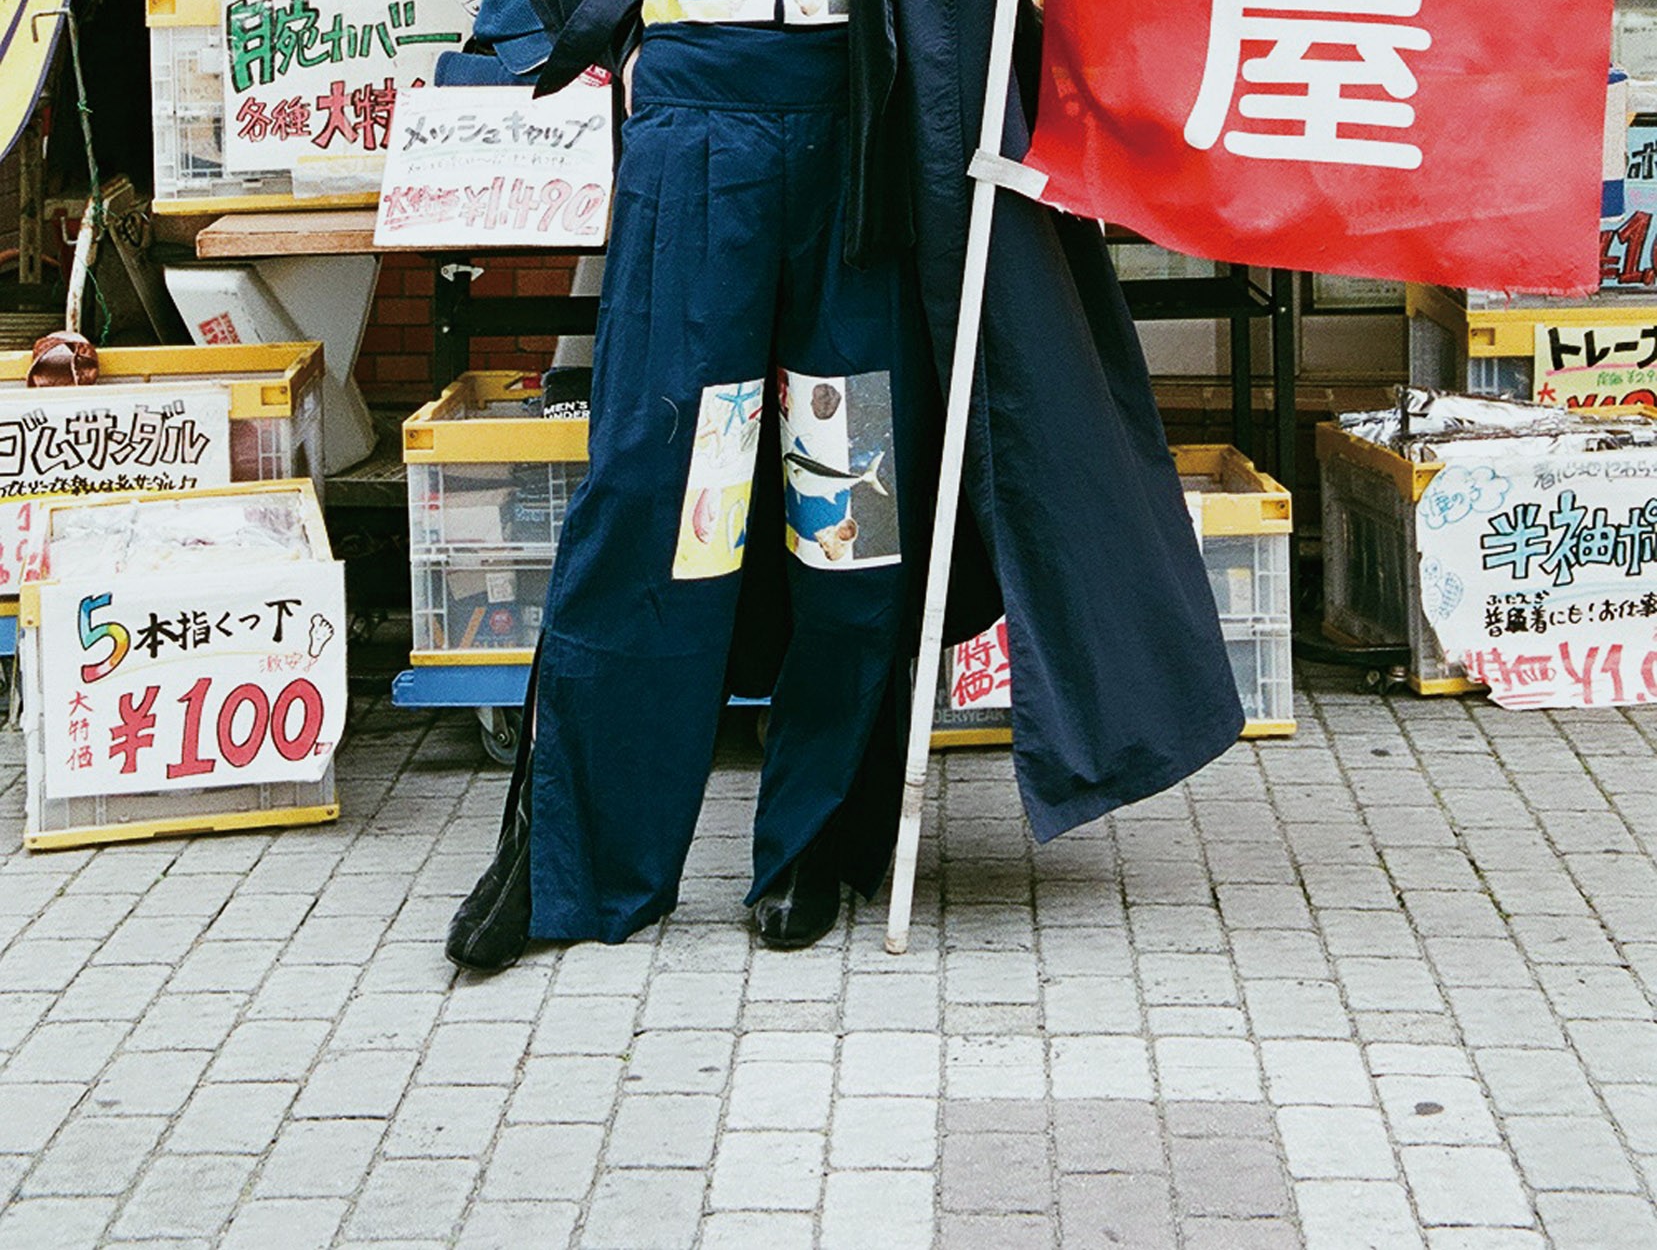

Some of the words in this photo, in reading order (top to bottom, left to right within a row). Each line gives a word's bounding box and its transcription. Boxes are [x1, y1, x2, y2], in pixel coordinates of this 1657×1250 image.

[402, 110, 607, 151] メッシュキャップ
[0, 399, 210, 477] ゴムサンダル
[78, 591, 302, 684] 5本指くつ下
[66, 690, 95, 771] 大特価
